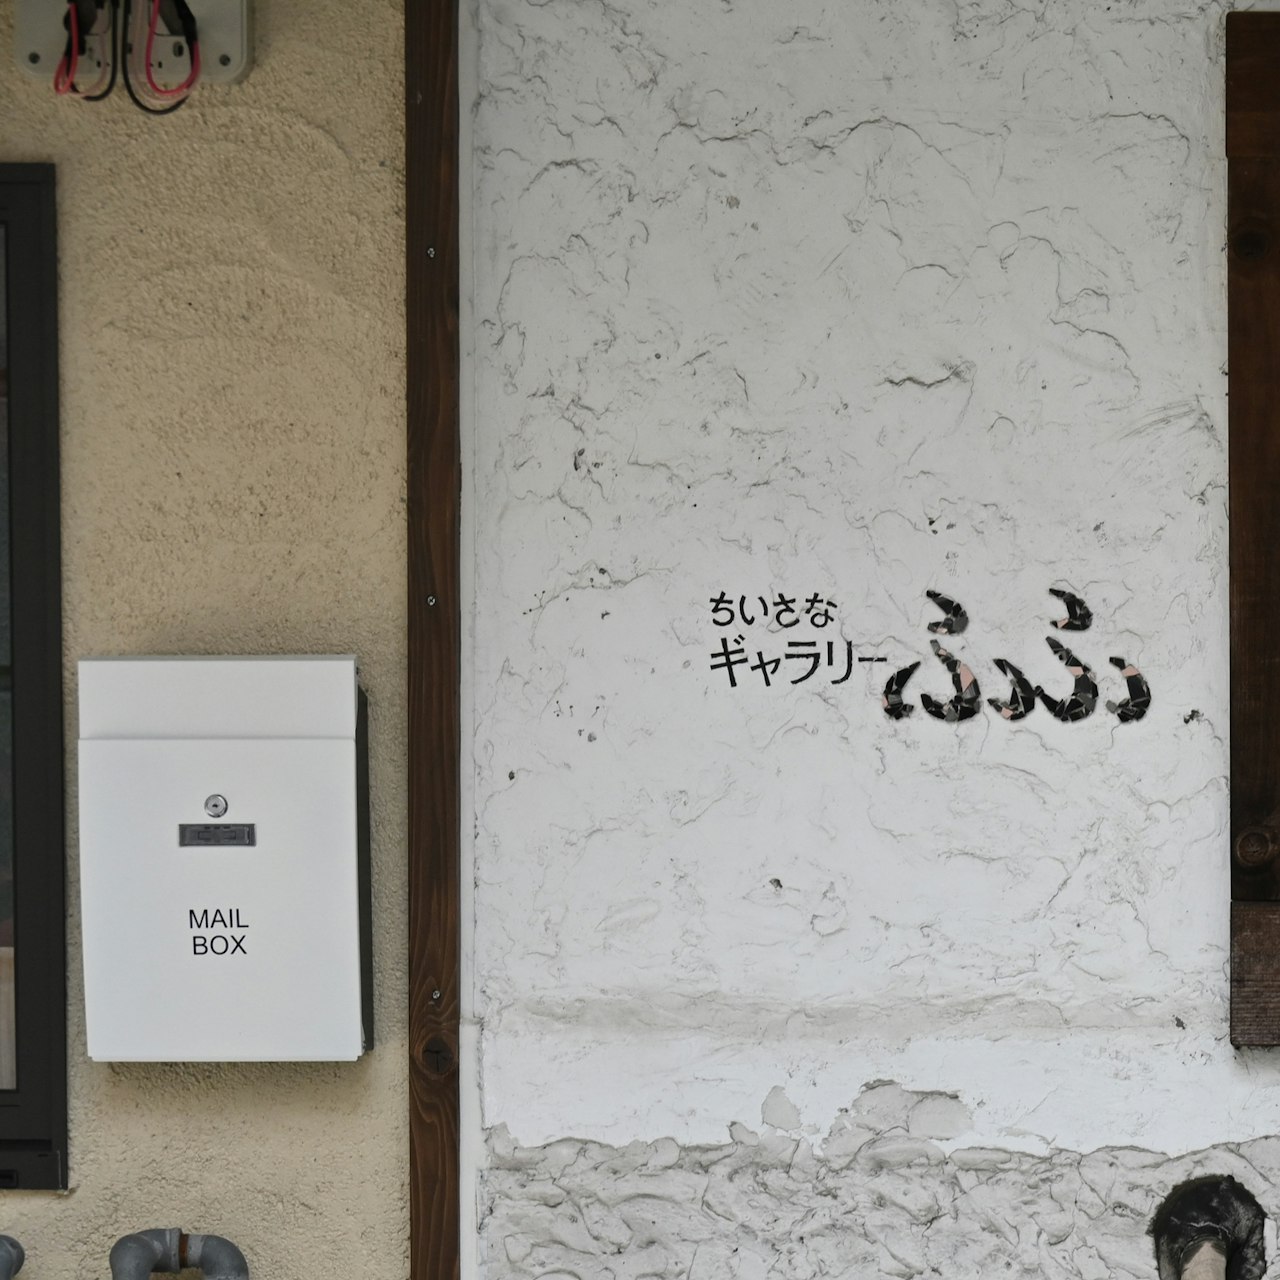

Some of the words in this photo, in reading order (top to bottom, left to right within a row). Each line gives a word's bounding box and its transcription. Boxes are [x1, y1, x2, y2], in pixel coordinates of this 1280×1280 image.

[709, 591, 838, 628] ちいさな
[709, 634, 888, 688] ギャラリー
[189, 908, 249, 929] MAIL
[192, 935, 248, 956] BOX
